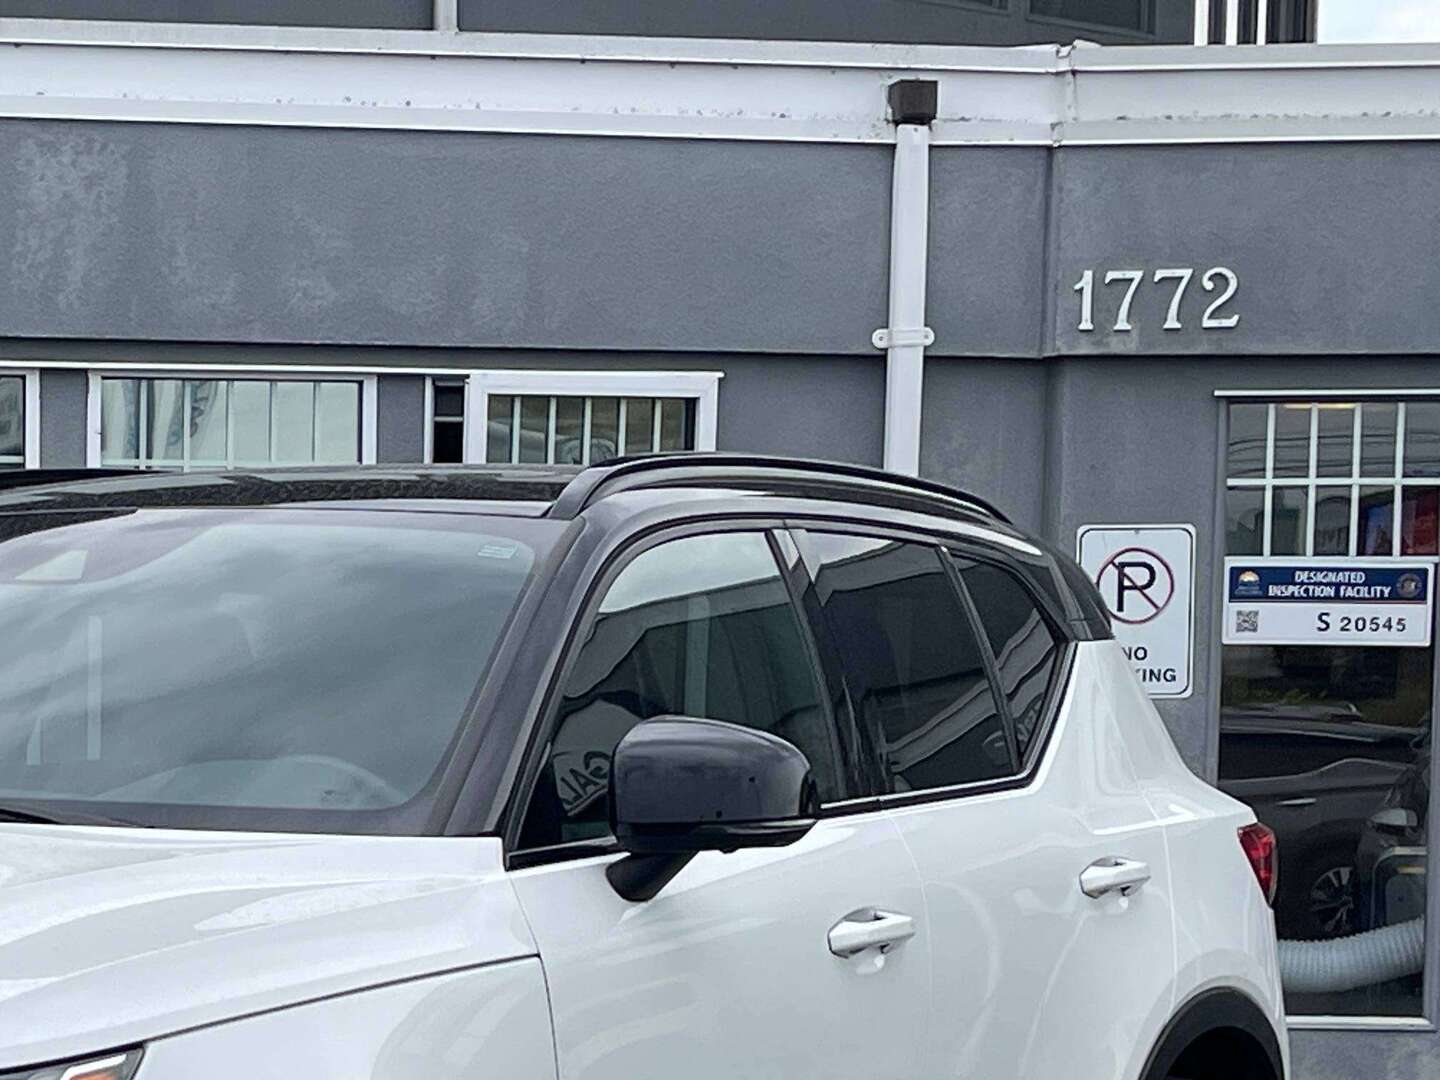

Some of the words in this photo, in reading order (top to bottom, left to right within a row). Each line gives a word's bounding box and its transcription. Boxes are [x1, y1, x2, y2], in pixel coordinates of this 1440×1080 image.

[1073, 266, 1241, 331] 1772
[1294, 570, 1366, 584] DESIGNATED
[1267, 585, 1335, 598] INSPECTION
[1340, 585, 1392, 598] FACILITY
[1316, 612, 1331, 632] S
[1339, 616, 1407, 632] 20545
